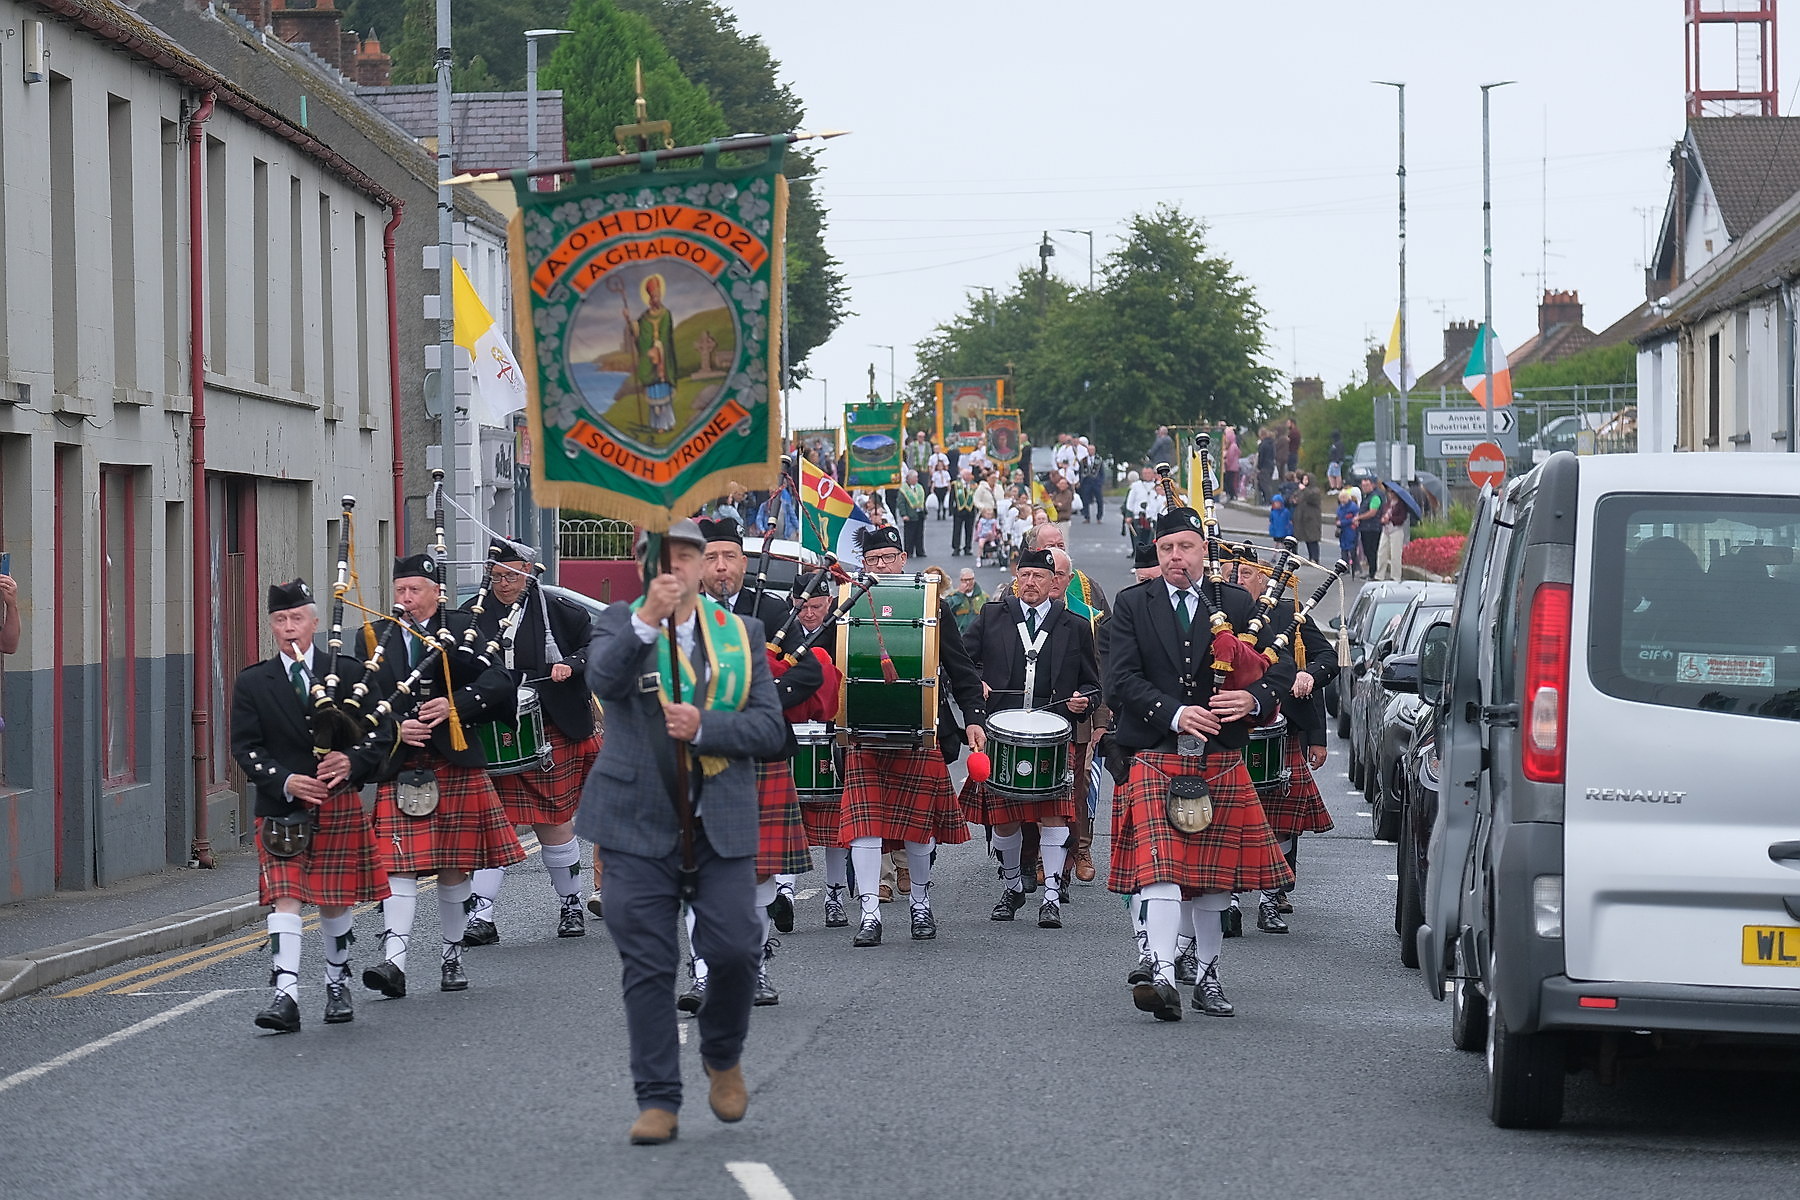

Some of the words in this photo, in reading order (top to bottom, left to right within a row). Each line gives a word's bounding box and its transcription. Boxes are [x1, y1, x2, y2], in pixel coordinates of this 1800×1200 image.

[635, 207, 682, 231] DIV
[588, 239, 707, 280] AGHALOO
[586, 432, 655, 480] SOUTH
[1585, 787, 1687, 804] RENAULT
[1756, 930, 1797, 961] WL
